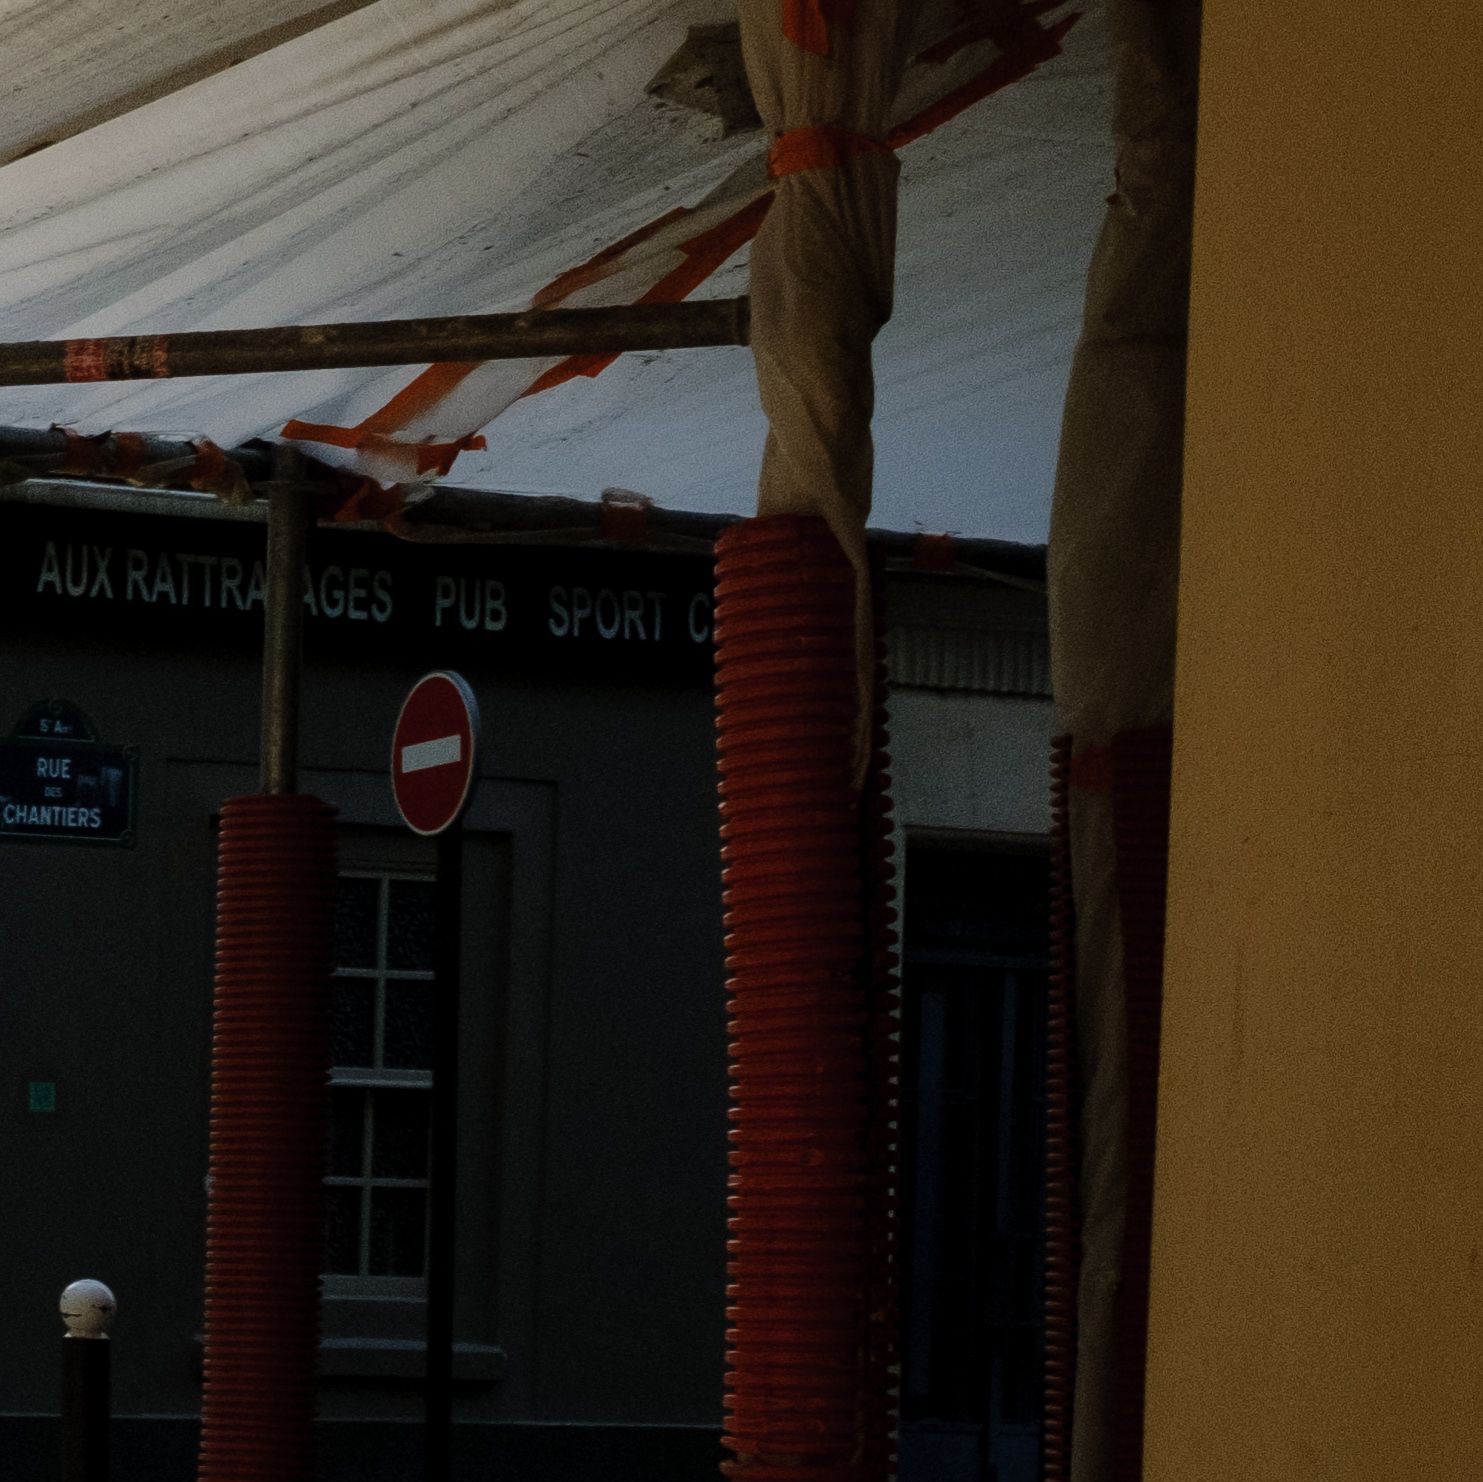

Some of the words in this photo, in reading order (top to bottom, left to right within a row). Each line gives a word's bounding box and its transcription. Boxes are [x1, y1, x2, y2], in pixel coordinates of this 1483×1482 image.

[35, 538, 115, 600] AUX
[125, 546, 394, 625] RATTRAAGES
[433, 575, 509, 633] PUB
[547, 583, 666, 645] SPORT
[687, 591, 713, 646] C
[36, 756, 72, 779] RUE
[2, 804, 103, 829] CHANTIERS
